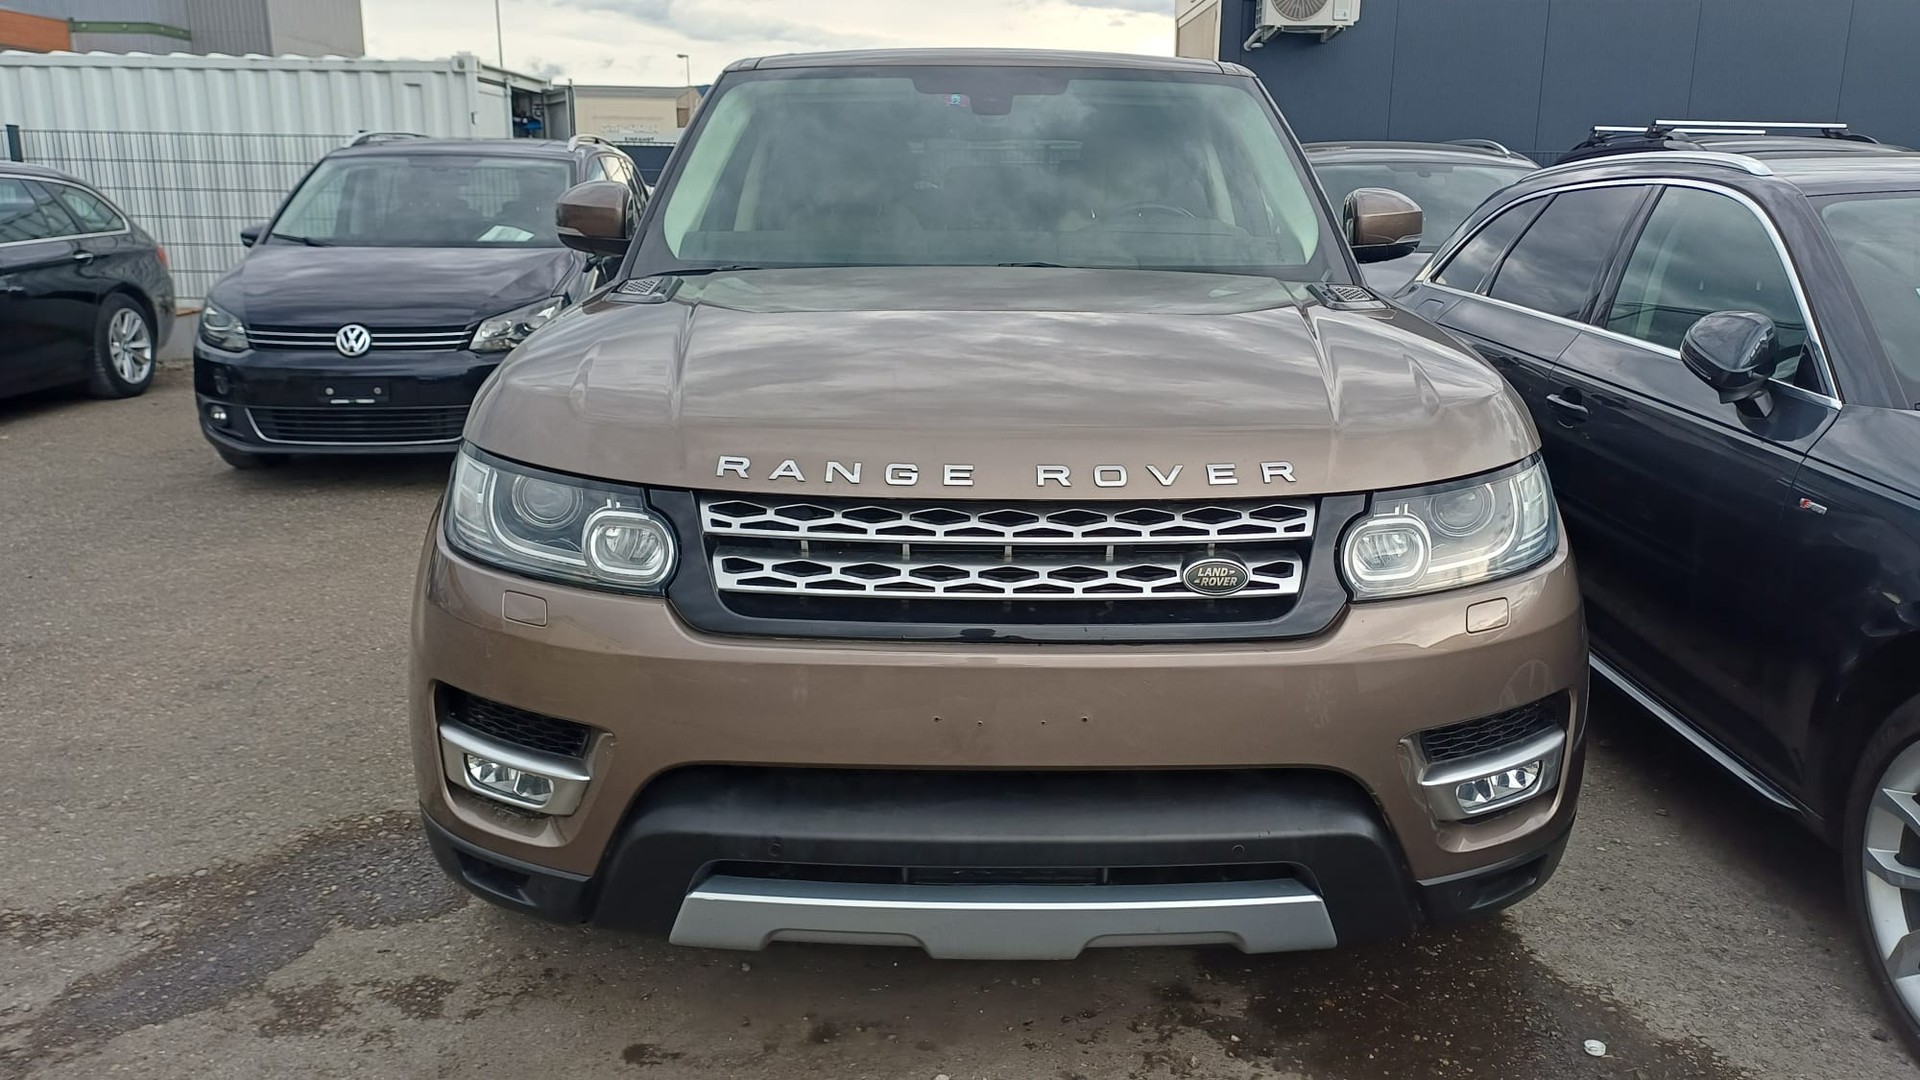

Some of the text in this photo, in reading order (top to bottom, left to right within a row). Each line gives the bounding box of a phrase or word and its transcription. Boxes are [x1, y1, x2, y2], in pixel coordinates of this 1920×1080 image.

[716, 455, 1297, 487] RANGE ROVER
[1197, 567, 1228, 577] LAND
[1200, 576, 1238, 587] ROVER
